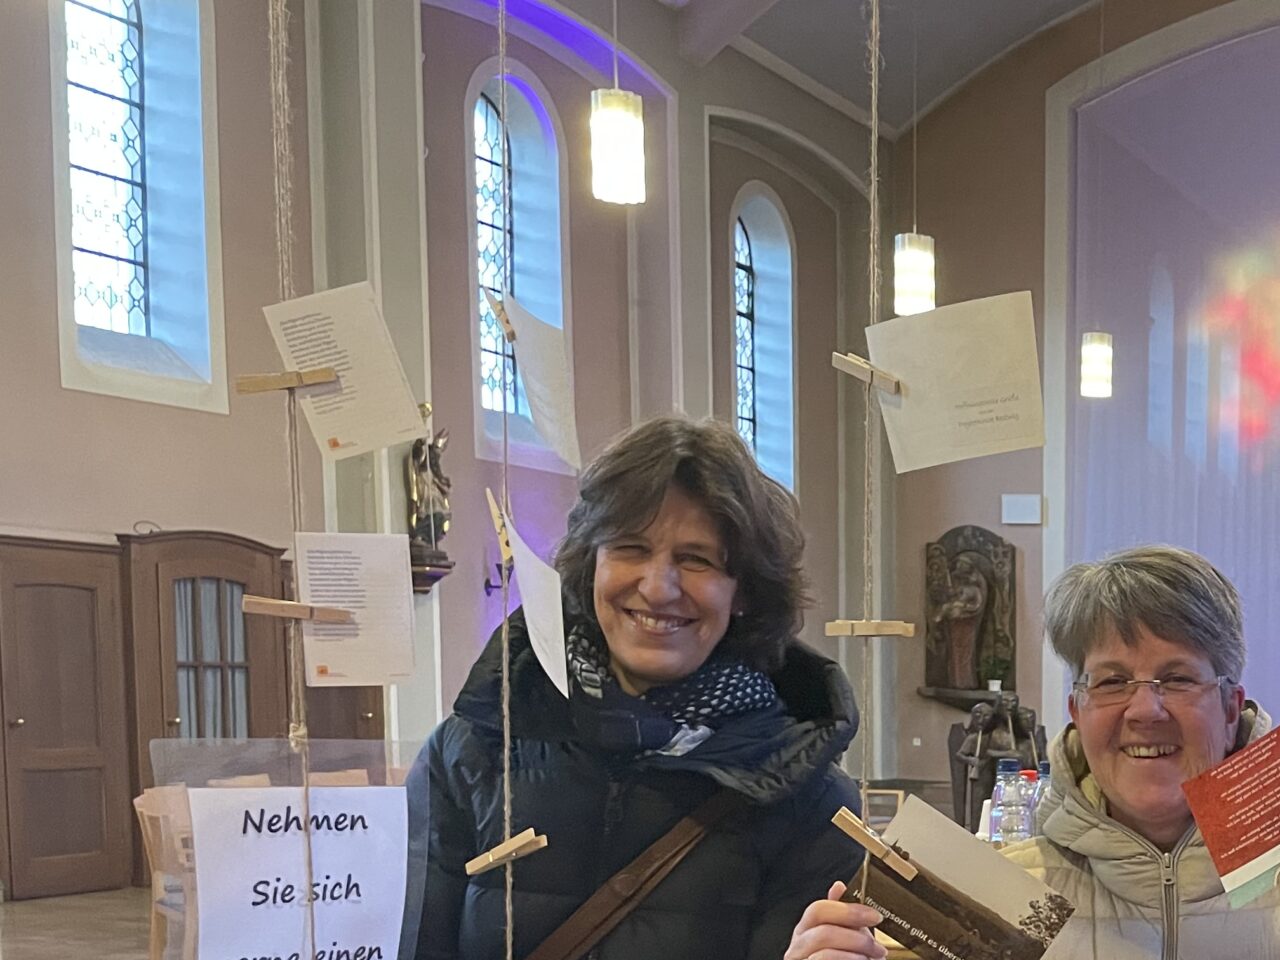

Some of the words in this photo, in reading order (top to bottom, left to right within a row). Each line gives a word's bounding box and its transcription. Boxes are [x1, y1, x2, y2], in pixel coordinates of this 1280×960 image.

[242, 806, 368, 834] Nehmen
[251, 877, 295, 906] Sie
[308, 874, 362, 902] sich
[910, 928, 928, 941] gibt
[927, 939, 937, 948] es
